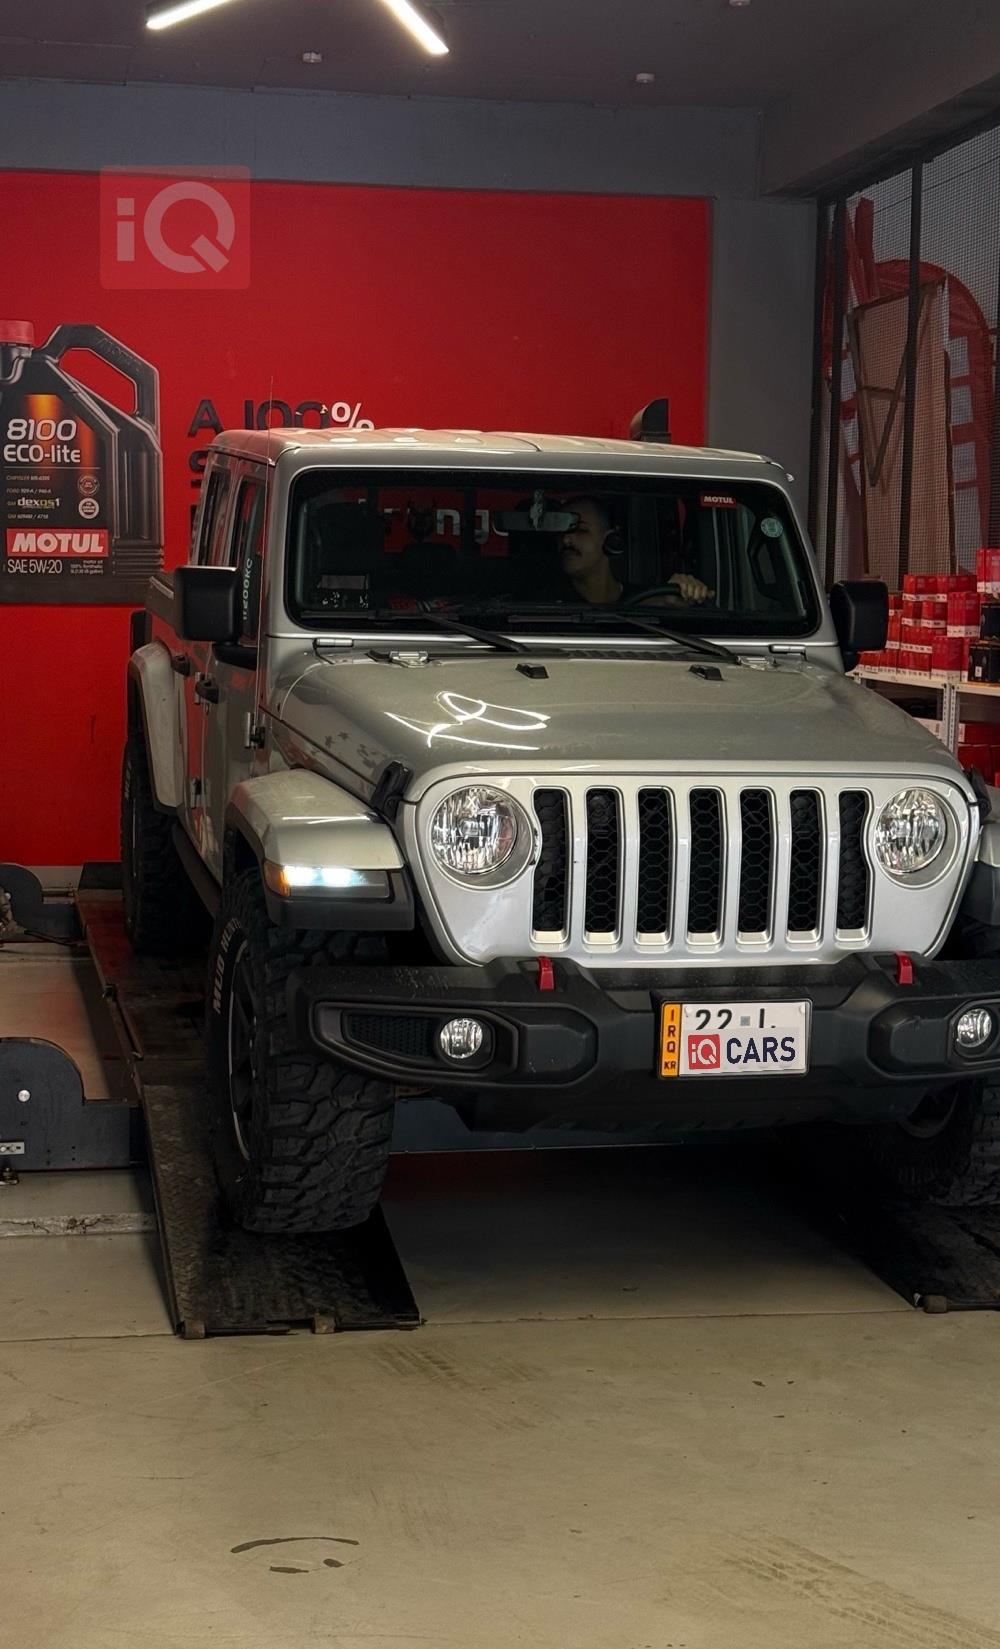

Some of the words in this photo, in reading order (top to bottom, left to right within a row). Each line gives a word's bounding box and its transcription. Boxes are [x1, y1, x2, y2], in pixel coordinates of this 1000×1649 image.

[188, 399, 225, 437] A
[7, 418, 77, 441] 8100
[3, 444, 81, 463] ECO-lite
[17, 497, 60, 507] dexos1
[703, 496, 734, 504] MOTUL
[12, 533, 104, 553] MOTUL
[7, 559, 29, 574] SAE
[29, 559, 63, 574] 5W-20
[213, 954, 225, 1015] MUD
[664, 1061, 676, 1070] KR
